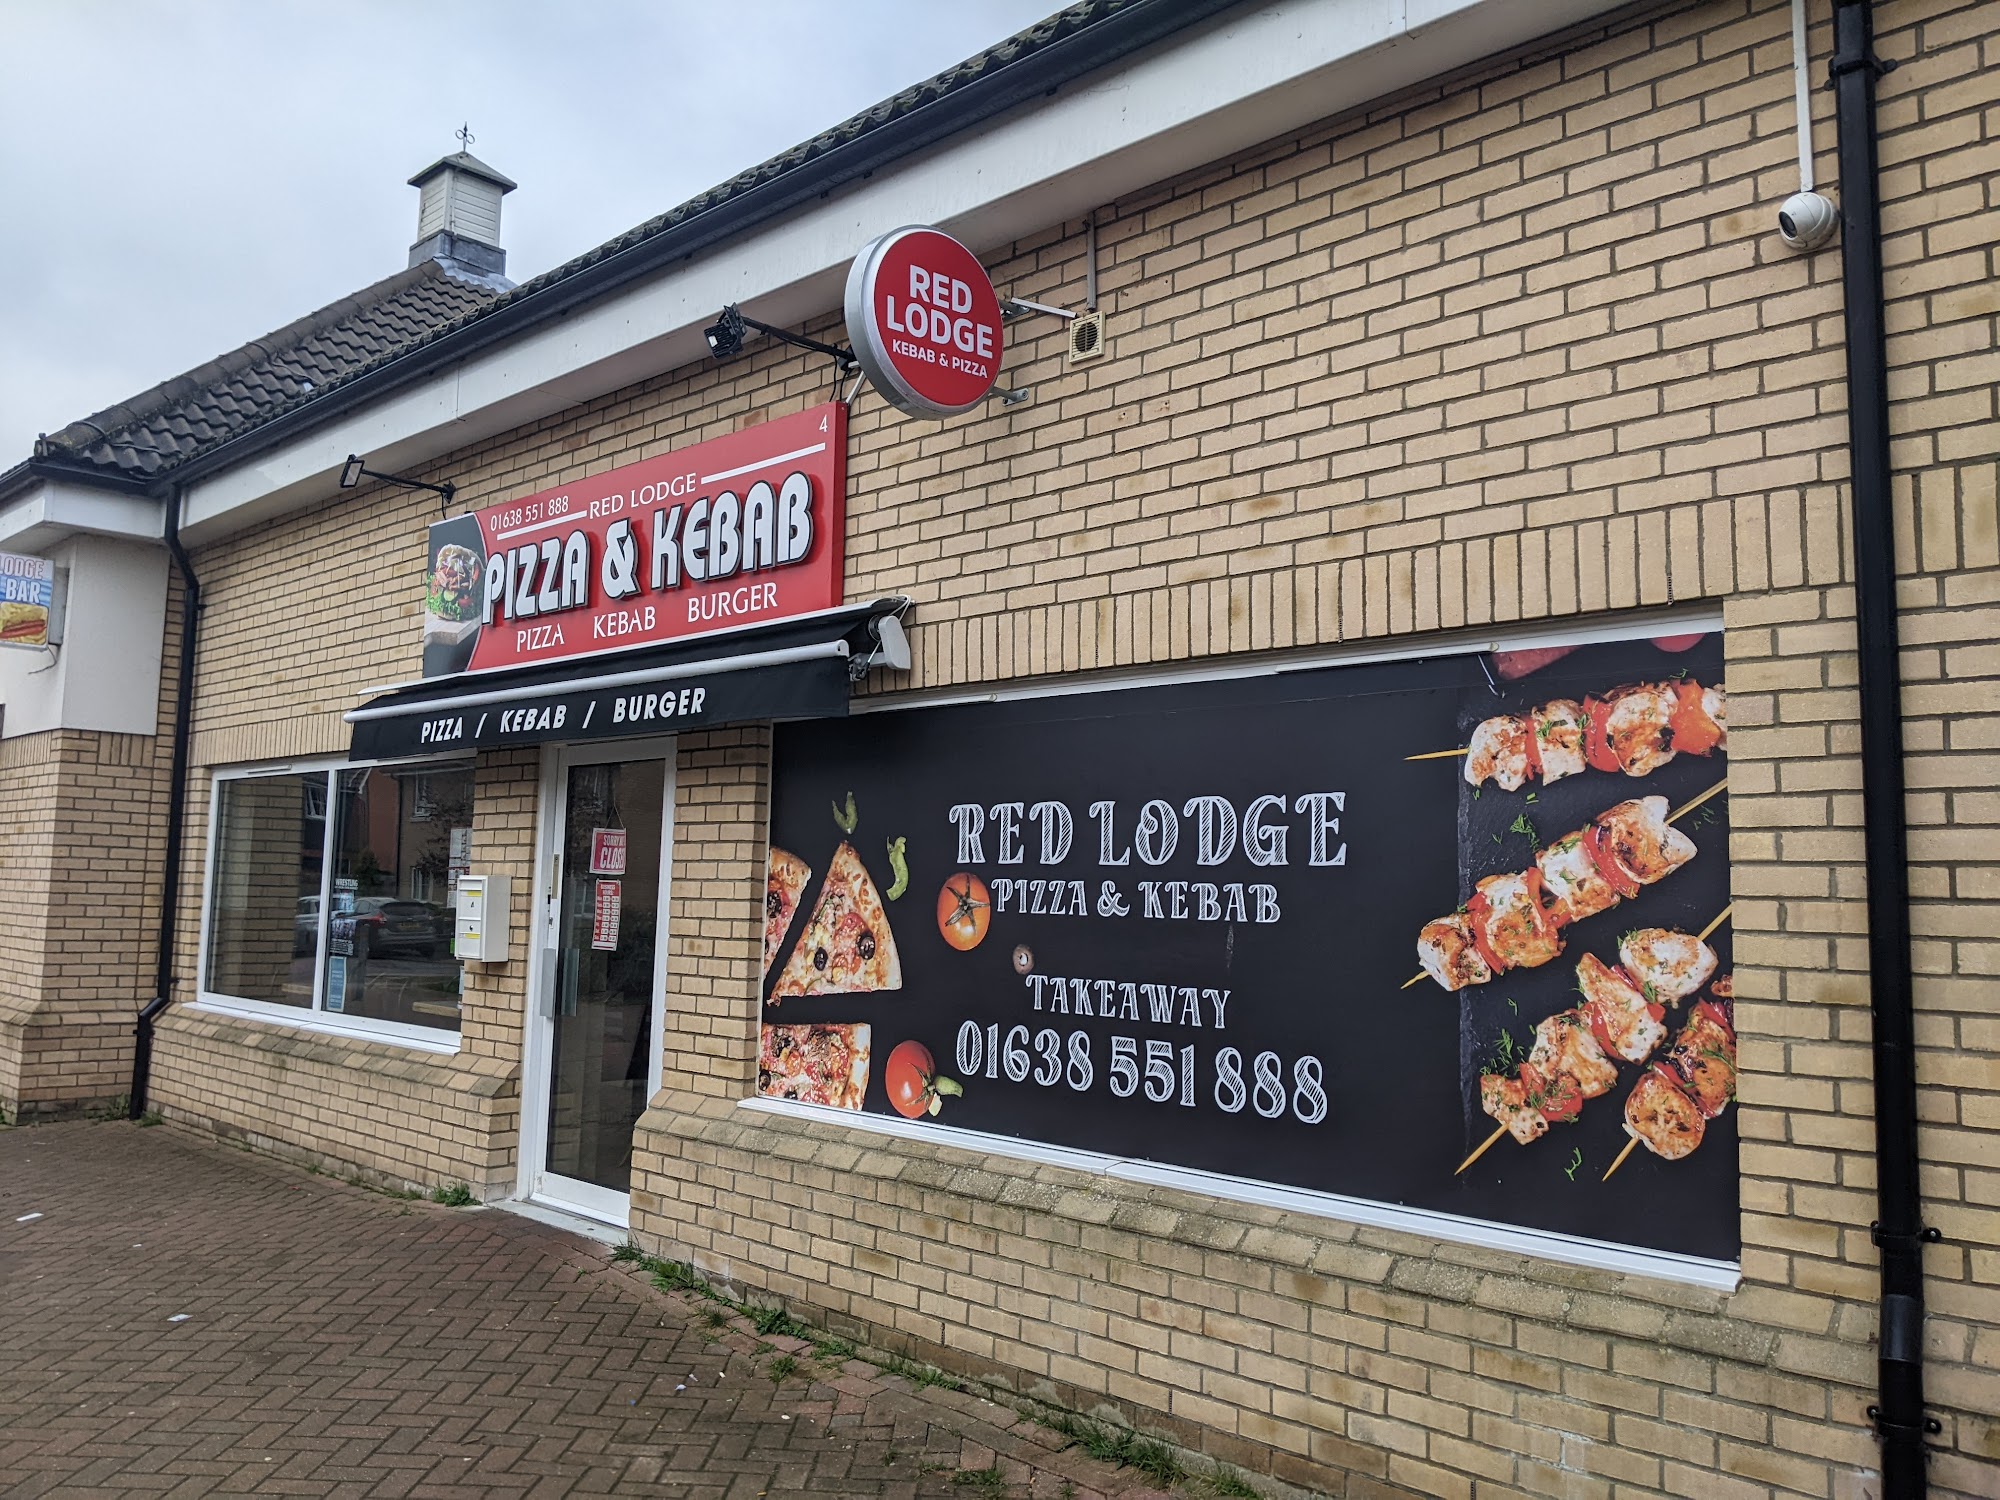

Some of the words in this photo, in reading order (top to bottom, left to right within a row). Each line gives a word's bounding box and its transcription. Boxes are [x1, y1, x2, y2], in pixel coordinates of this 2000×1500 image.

[910, 264, 972, 314] RED
[887, 295, 993, 358] LODGE
[893, 339, 936, 363] KEBAB
[938, 352, 948, 367] &
[951, 356, 987, 378] PIZZA
[819, 414, 828, 433] 4
[490, 511, 522, 532] 01638
[525, 504, 544, 524] 551
[548, 495, 569, 516] 888
[589, 494, 623, 519] RED
[631, 473, 696, 509] LODGE
[0, 556, 44, 580] ODGE
[482, 529, 589, 626] PIZZA
[601, 517, 639, 599] &
[651, 470, 814, 590] KEBAB
[5, 578, 41, 604] BAR
[517, 623, 564, 652] PIZZA
[593, 606, 656, 639] KEBAB
[688, 583, 778, 623] BURGER
[421, 718, 463, 744] PIZZA
[475, 712, 488, 738] /
[500, 705, 567, 733] KEBAB
[582, 701, 596, 729] /
[613, 687, 706, 723] BURGER
[949, 800, 1073, 865] RED
[1089, 792, 1347, 867] LODGE
[991, 878, 1088, 916] PIZZA
[1096, 879, 1130, 918] &
[1138, 880, 1281, 924] KEBAB
[1025, 974, 1231, 1030] TAKEAWAY
[956, 1020, 1094, 1092] 01638
[1110, 1035, 1196, 1108] 551
[1214, 1046, 1328, 1125] 888
